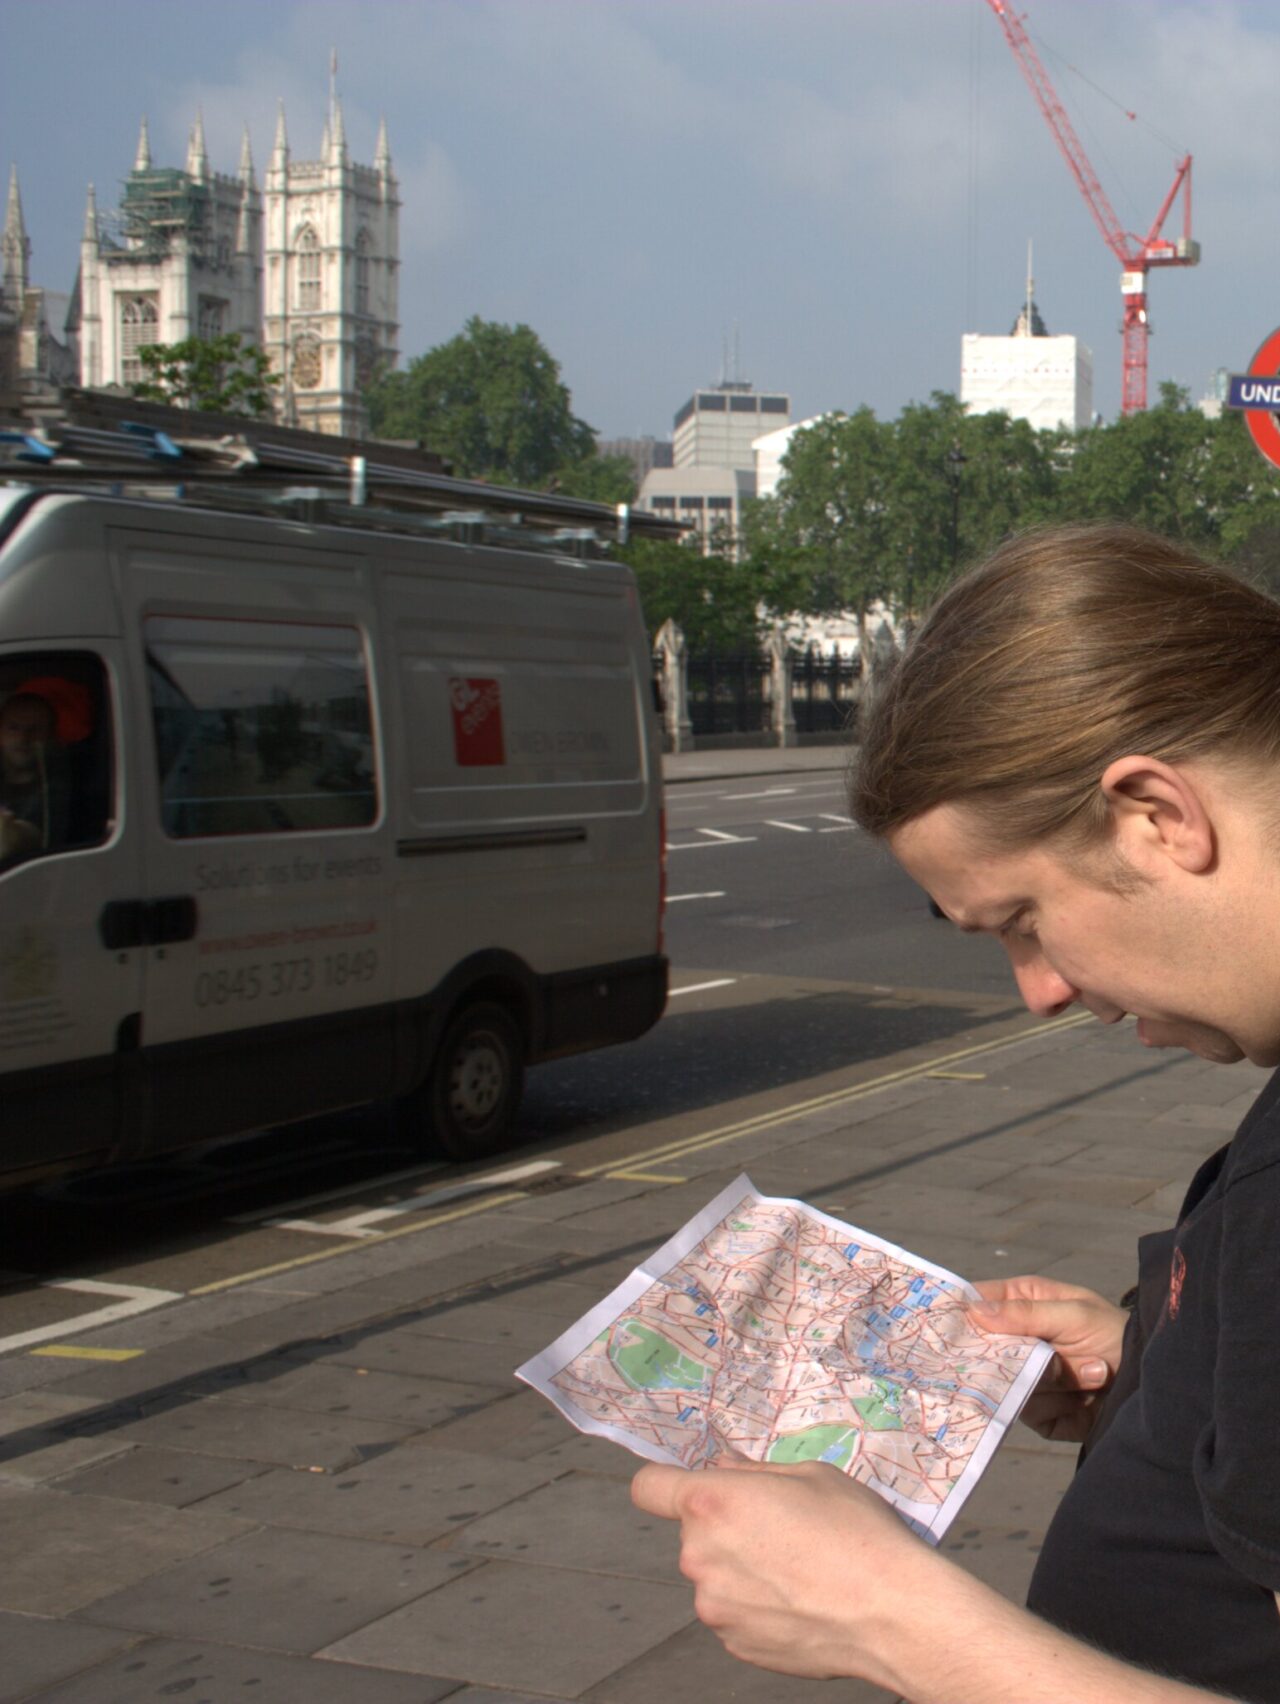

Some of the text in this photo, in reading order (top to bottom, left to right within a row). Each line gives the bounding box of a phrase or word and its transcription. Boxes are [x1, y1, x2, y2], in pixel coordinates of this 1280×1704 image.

[293, 856, 319, 881] for
[325, 857, 382, 879] events
[194, 949, 378, 1008] 0845 373 1849
